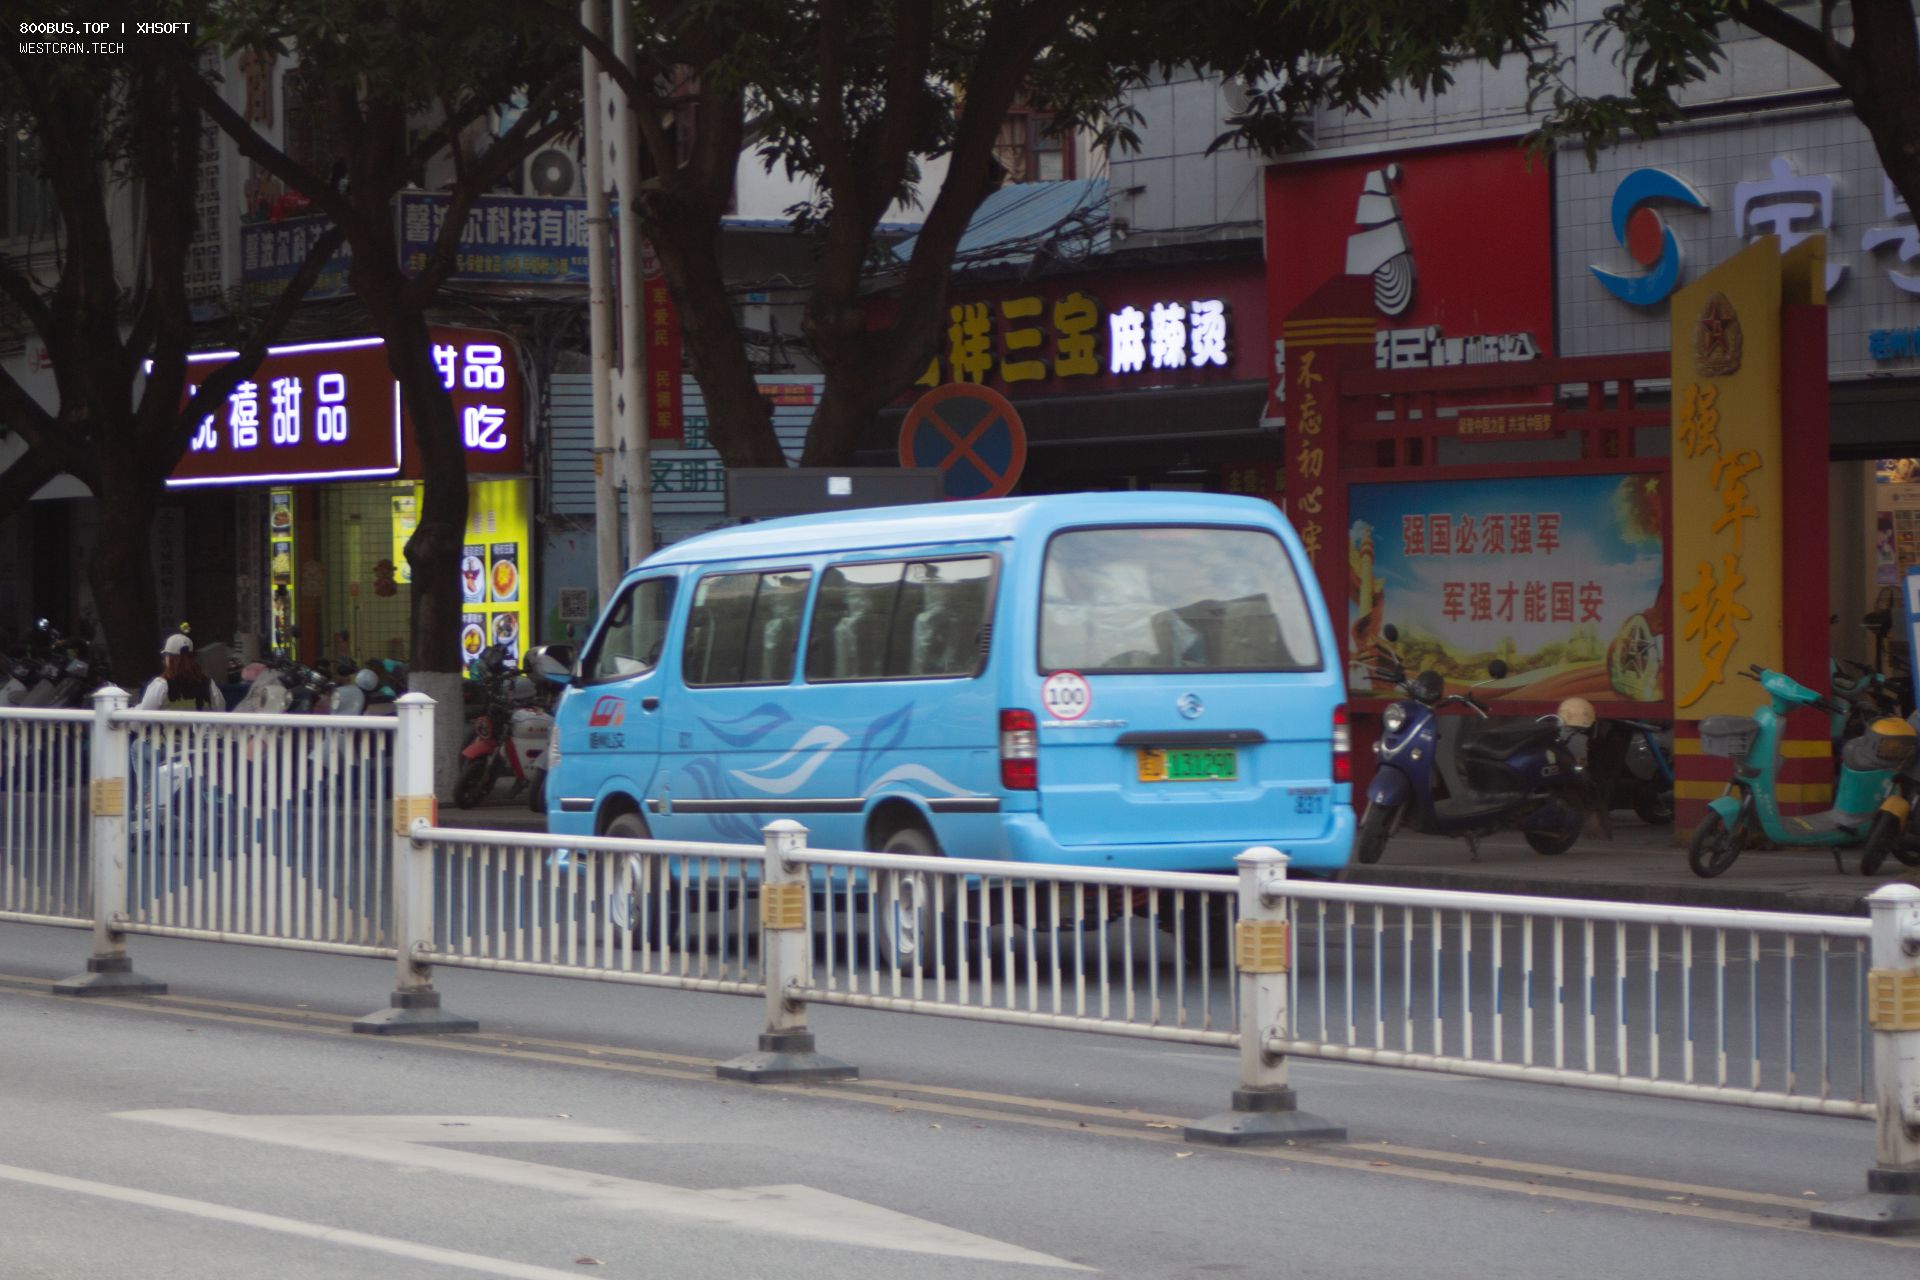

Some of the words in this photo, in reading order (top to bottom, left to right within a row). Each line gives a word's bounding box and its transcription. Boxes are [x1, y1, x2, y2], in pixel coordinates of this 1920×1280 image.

[406, 203, 613, 247] 馨尔科技有限
[916, 291, 1100, 386] 祥三宝
[1110, 299, 1228, 374] 麻辣烫
[463, 404, 508, 450] 吃
[1402, 512, 1562, 556] 强国必须强军
[1442, 581, 1604, 623] 军强才能国安
[1047, 687, 1085, 706] 100
